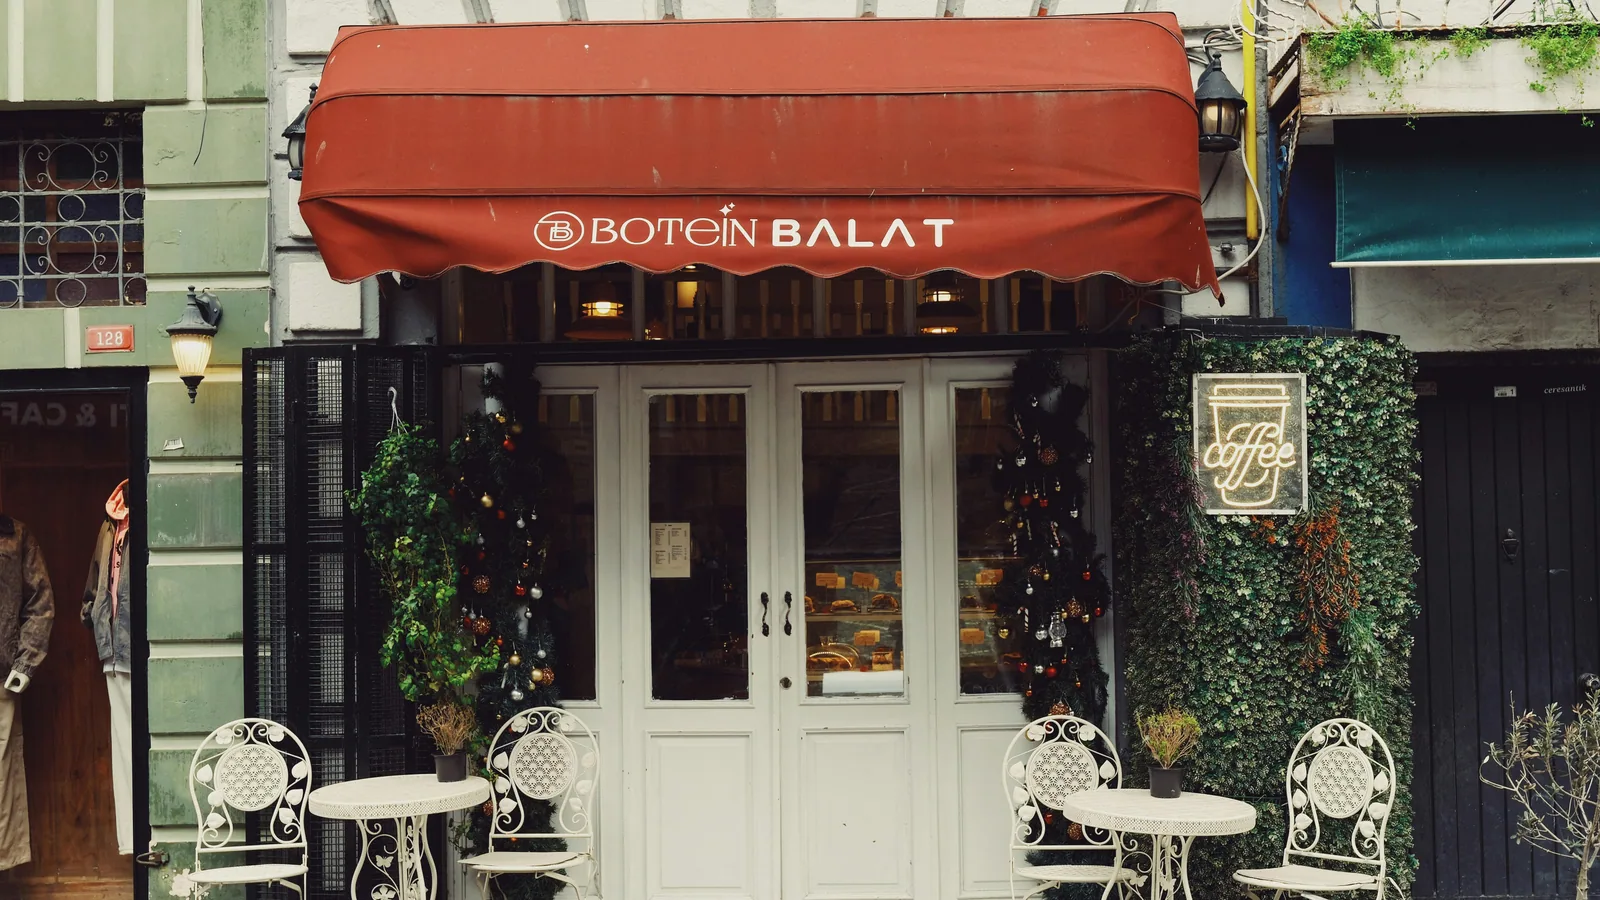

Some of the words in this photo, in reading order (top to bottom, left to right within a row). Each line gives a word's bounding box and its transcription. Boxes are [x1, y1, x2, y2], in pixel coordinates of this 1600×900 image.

[772, 218, 954, 248] BALAT
[96, 331, 123, 346] 128
[1203, 422, 1297, 490] coffee
